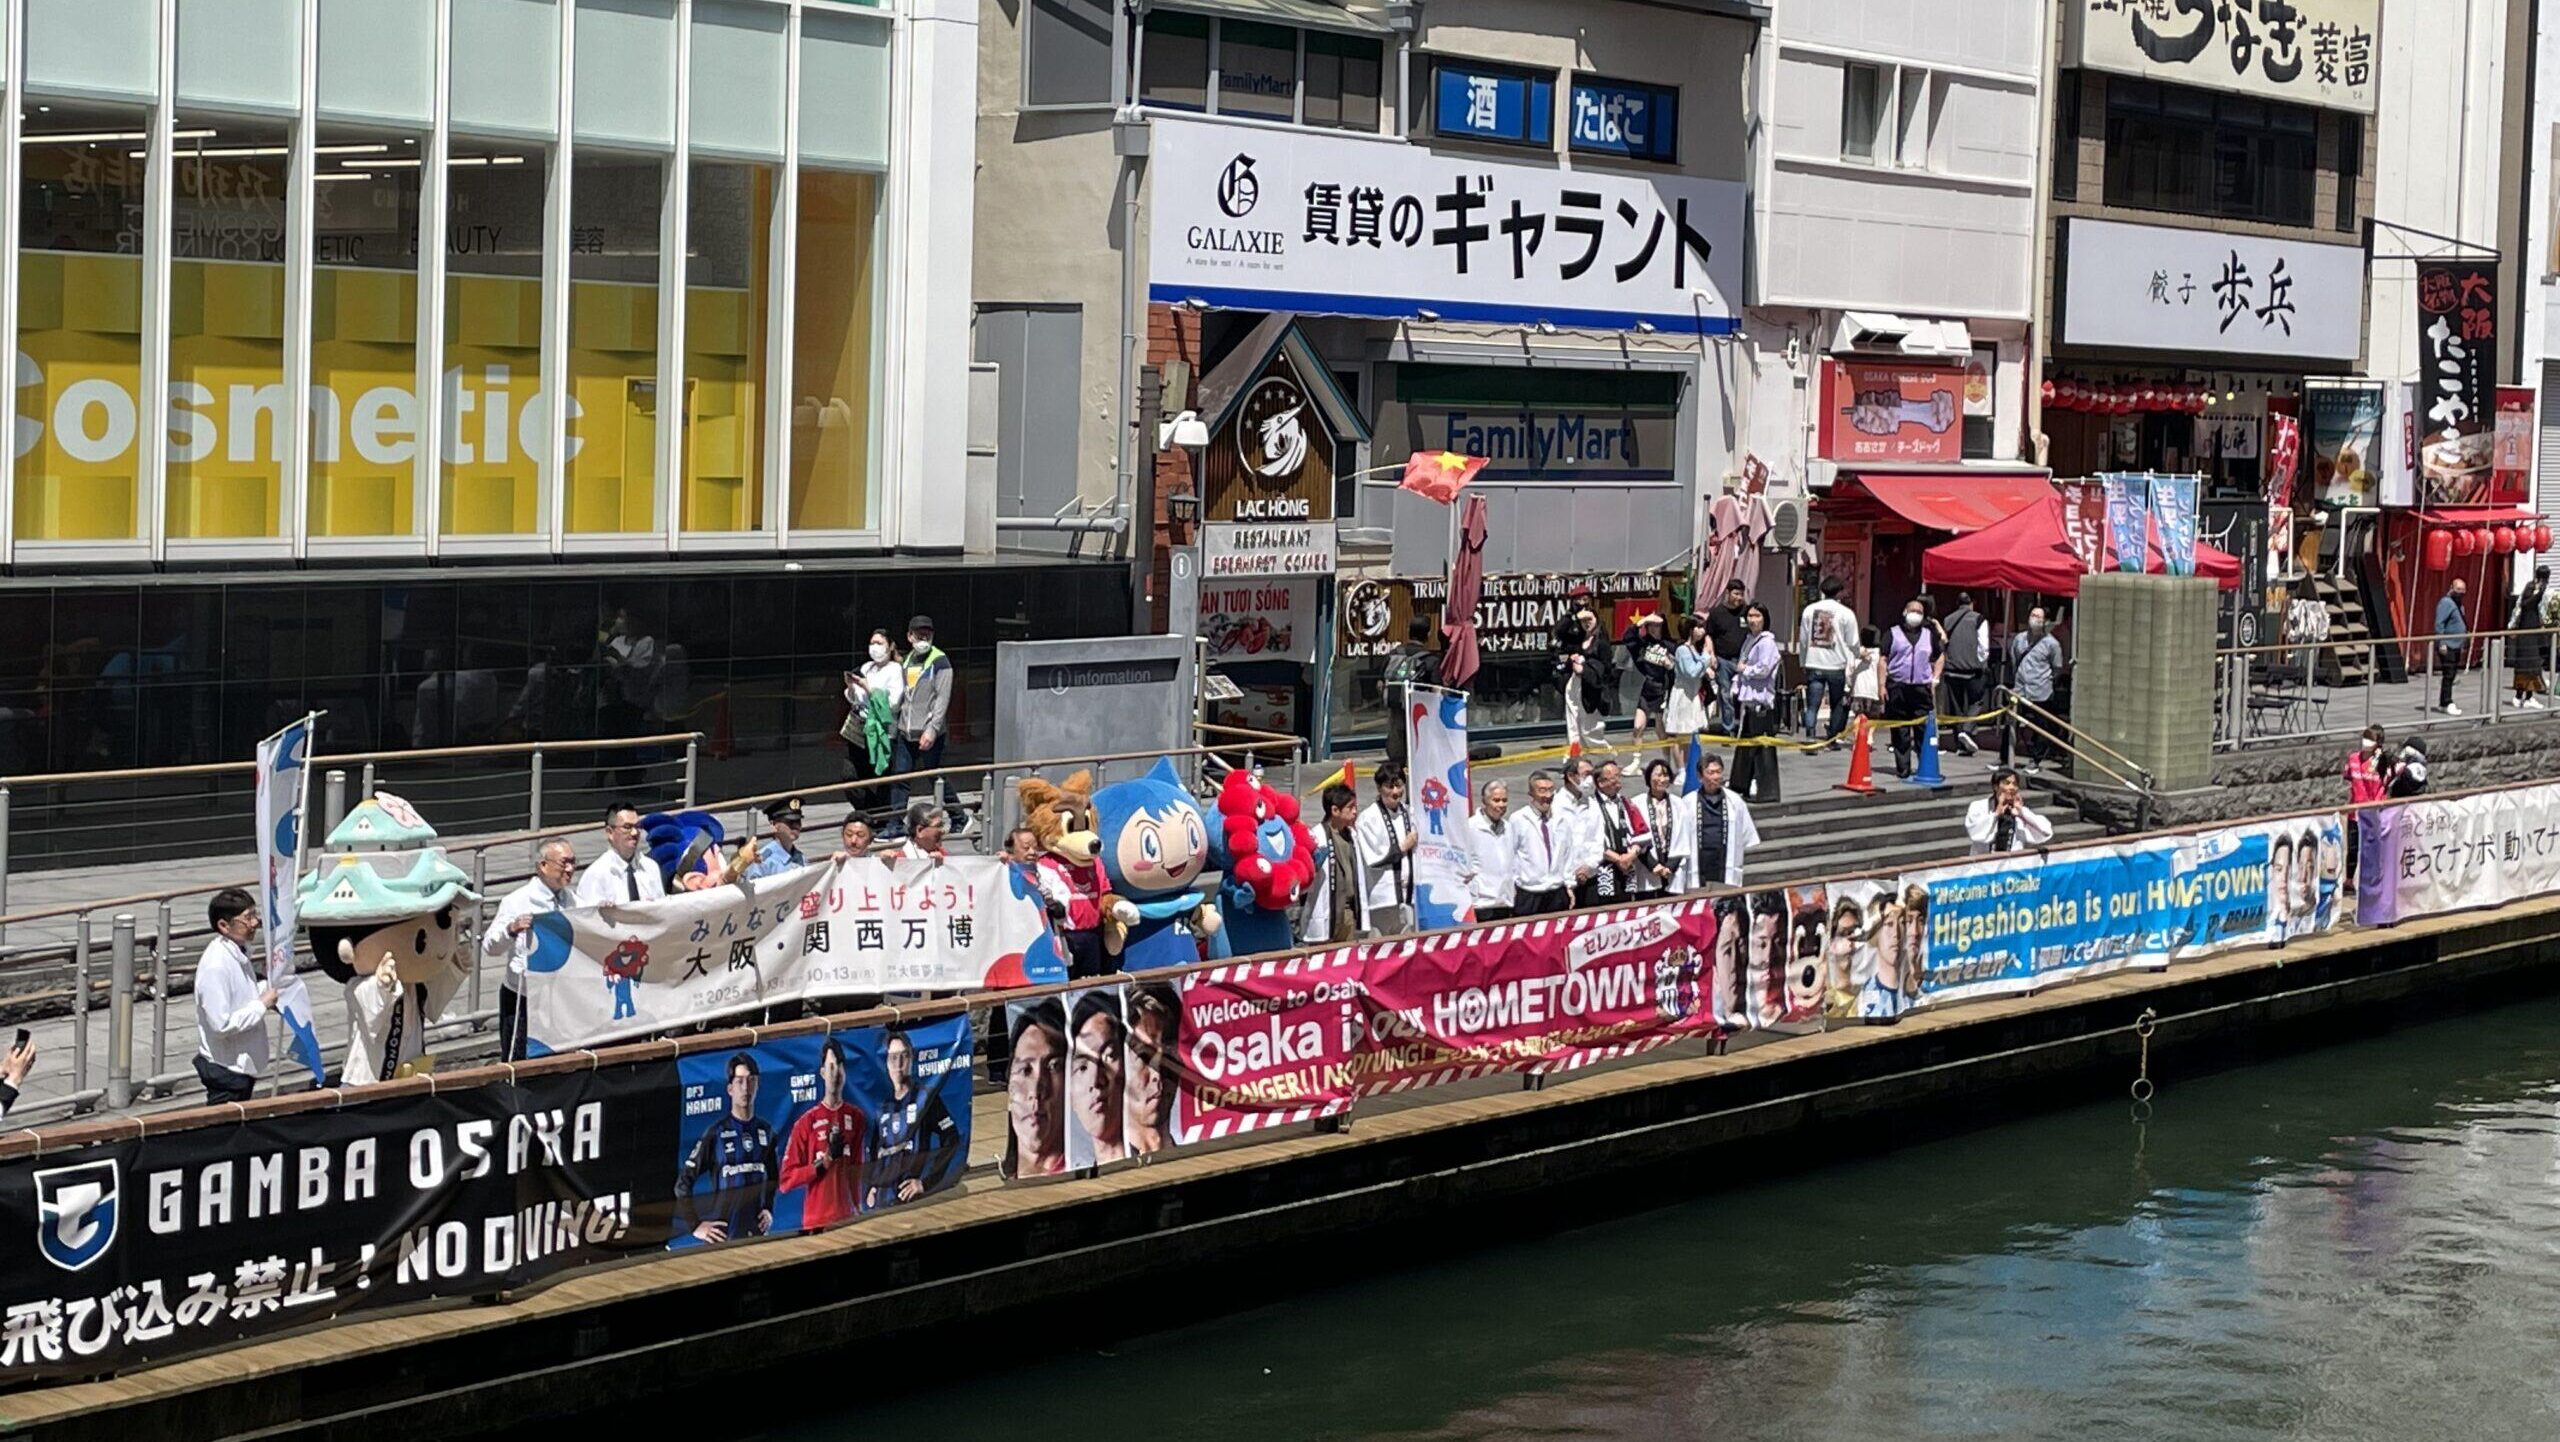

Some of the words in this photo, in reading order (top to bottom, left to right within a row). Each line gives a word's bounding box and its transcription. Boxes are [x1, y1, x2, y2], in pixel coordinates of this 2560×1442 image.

[2310, 22, 2371, 86] 菱富
[1218, 69, 1292, 95] FamilyMart
[1465, 76, 1498, 130] 酒
[1575, 89, 1645, 145] たばこ
[261, 236, 364, 262] COETIC
[1186, 226, 1285, 255] GALAXIE
[1302, 175, 1712, 289] 賃貸のギャラント
[2148, 269, 2196, 304] 餃子
[2211, 249, 2295, 337] 歩兵
[2460, 272, 2494, 340] 大阪
[18, 349, 585, 465] osmetic
[1447, 411, 1631, 467] FamilyMart
[1233, 528, 1311, 550] RESTAURANT
[1413, 581, 1448, 598] TRUN
[1441, 599, 1571, 630] STAURAN
[1074, 667, 1151, 686] information
[2400, 835, 2496, 879] 使ってナンボ
[1934, 883, 1988, 905] Welcome
[2085, 889, 2102, 923] is
[1584, 916, 1664, 956] セレッソ大阪
[1190, 1014, 1323, 1081] Osaka
[1432, 961, 1647, 1038] HOMETOWN
[1191, 996, 1281, 1028] Welcome
[1286, 988, 1307, 1009] to
[685, 1097, 722, 1116] HANDA
[790, 1087, 817, 1103] TANI
[148, 1137, 377, 1235] GAMBA
[409, 1101, 602, 1189] OSAKA
[397, 1220, 468, 1285] NO
[483, 1191, 631, 1275] DIVING!
